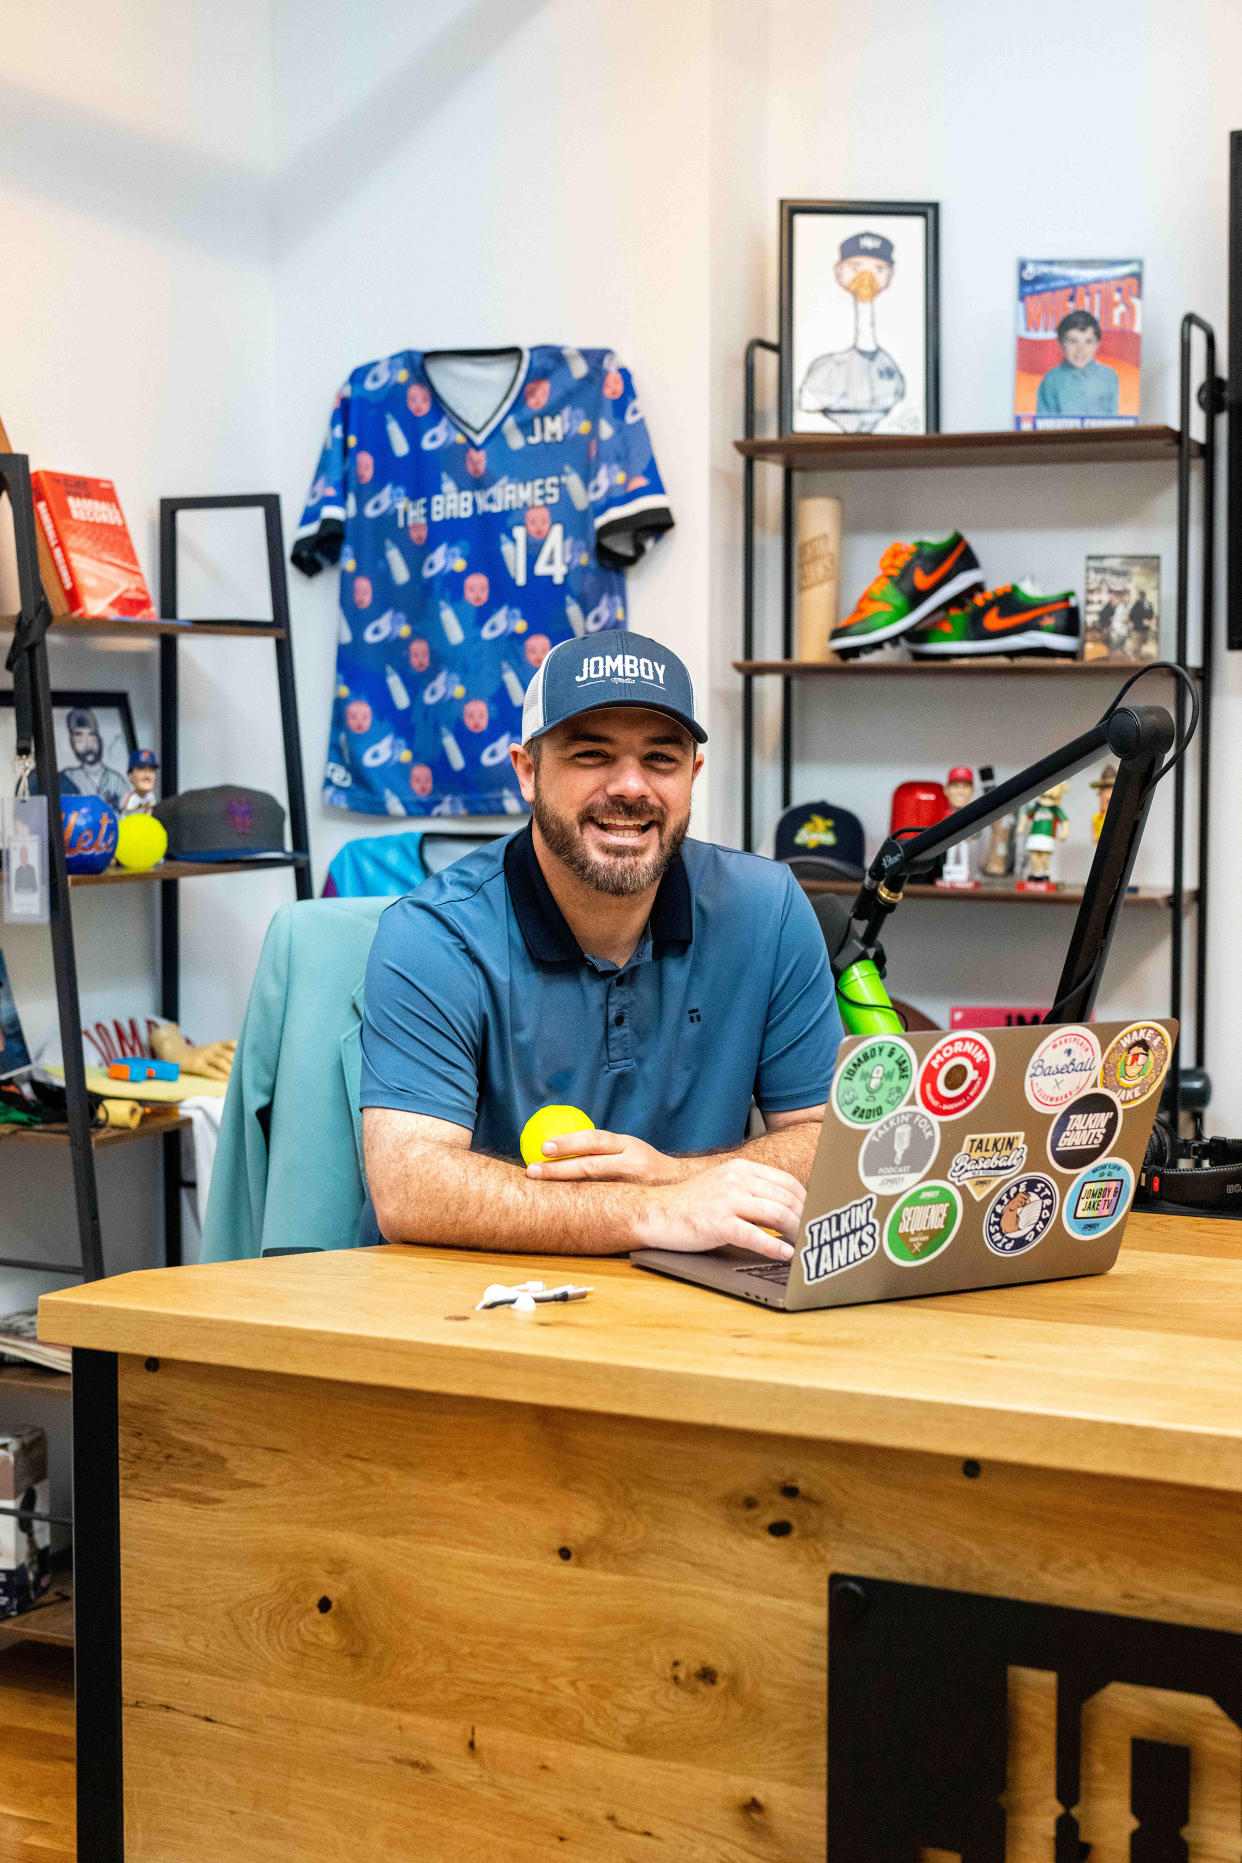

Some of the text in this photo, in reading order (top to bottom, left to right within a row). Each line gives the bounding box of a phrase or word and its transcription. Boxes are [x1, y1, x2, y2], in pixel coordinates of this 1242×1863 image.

[527, 414, 563, 445] JM
[395, 498, 427, 528] THE
[512, 523, 568, 587] 14
[575, 654, 666, 685] JOMBOY
[61, 811, 114, 858] ets
[1120, 1028, 1154, 1048] WAKE
[844, 1045, 884, 1081] JOMBOY
[895, 1054, 909, 1081] JAKE
[930, 1040, 988, 1069] MORNIN'
[1029, 1057, 1096, 1078] Baseball
[851, 1105, 883, 1120] RADIO
[1066, 1112, 1114, 1129] TALKIN'
[871, 1114, 934, 1142] TALKIN' FOLK
[1057, 1128, 1106, 1148] GIANTS
[969, 1136, 1018, 1152] TALKIN'
[951, 1147, 1025, 1177] Baseball
[1081, 1187, 1112, 1200] JOMBOY
[1082, 1199, 1113, 1211] JAKE TV
[811, 1199, 873, 1248] TALKIN'
[899, 1203, 950, 1234] SEQUENCE
[990, 1181, 1052, 1250] PINSTRIPE STRONG
[805, 1224, 876, 1281] YANKS
